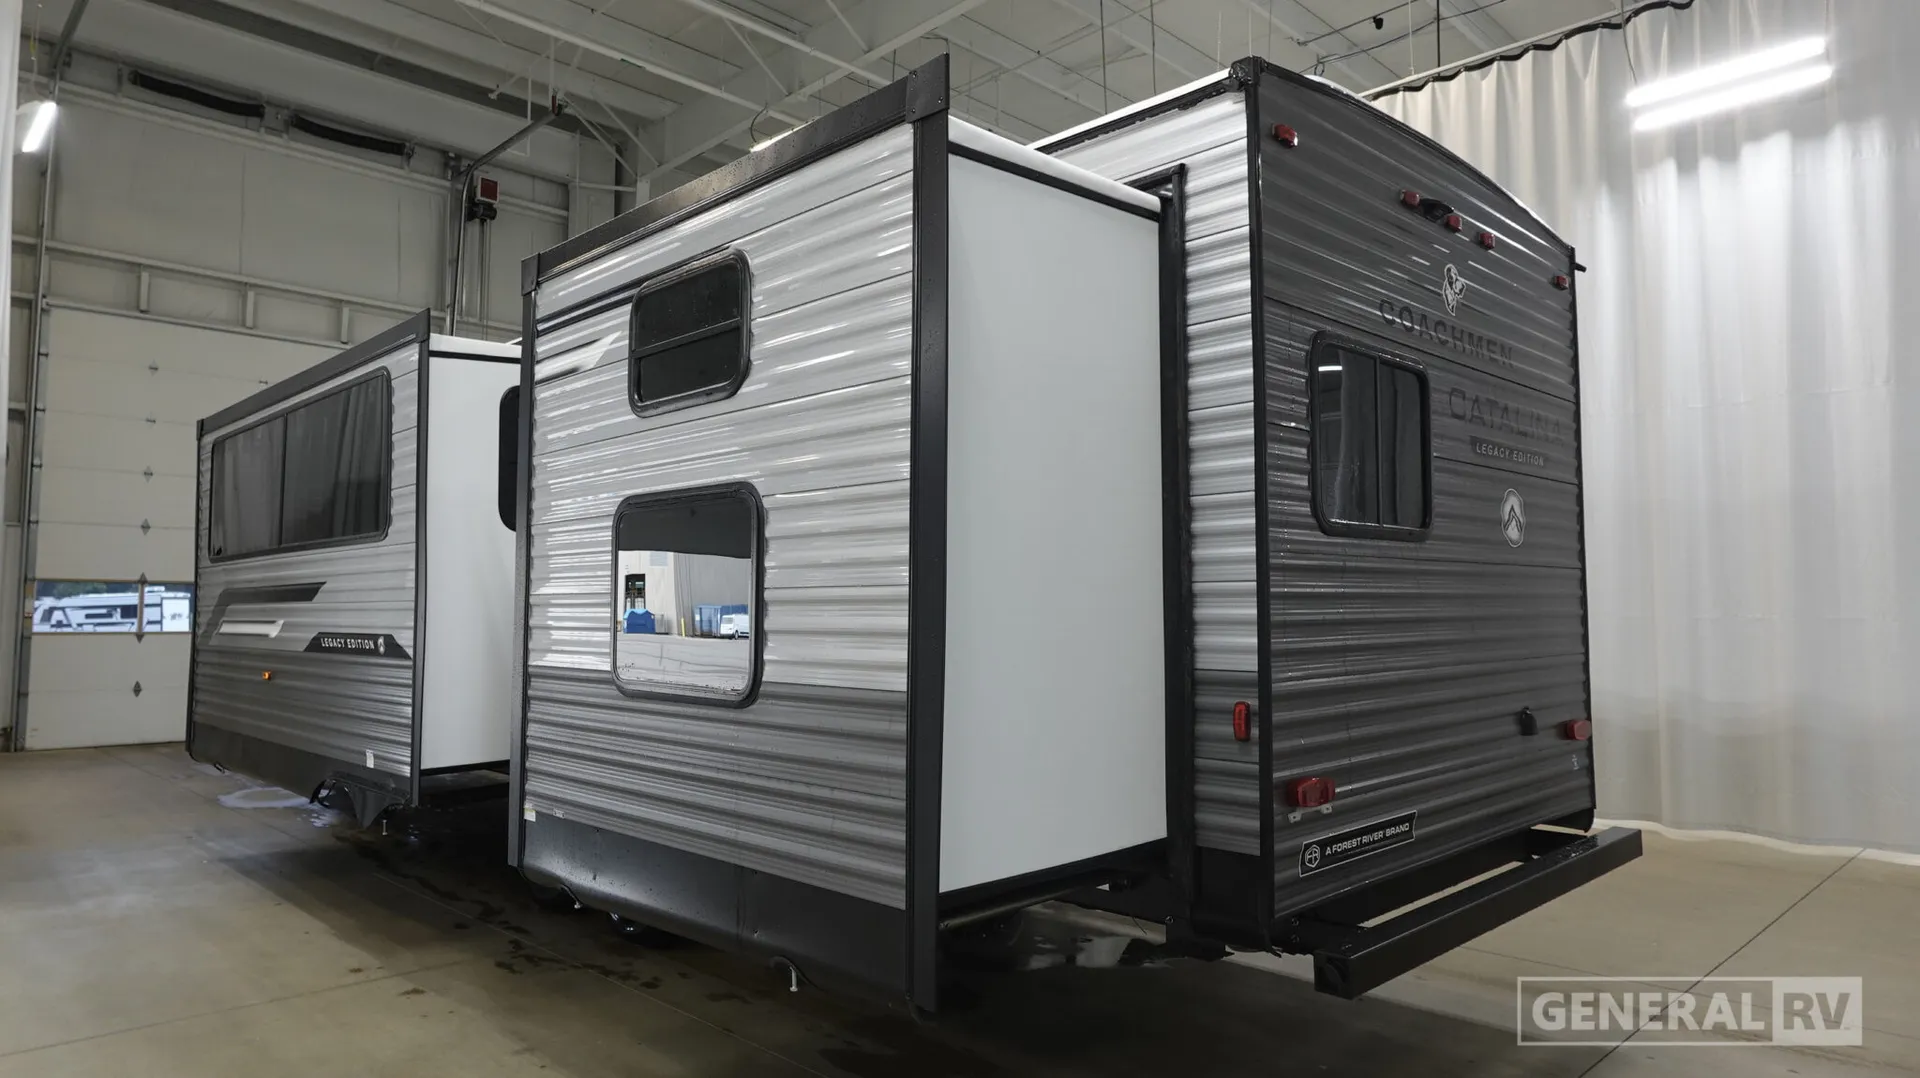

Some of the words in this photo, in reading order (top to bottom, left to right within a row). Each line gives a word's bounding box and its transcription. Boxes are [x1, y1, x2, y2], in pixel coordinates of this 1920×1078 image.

[1379, 299, 1515, 370] COACHMEN
[1476, 442, 1510, 459] LEGACY
[1512, 450, 1544, 467] EDITION
[320, 637, 345, 648] LEGACY
[346, 638, 375, 650] EDITION
[1325, 846, 1332, 856] A
[1332, 837, 1362, 854] FOREST
[1385, 822, 1410, 837] BRAND
